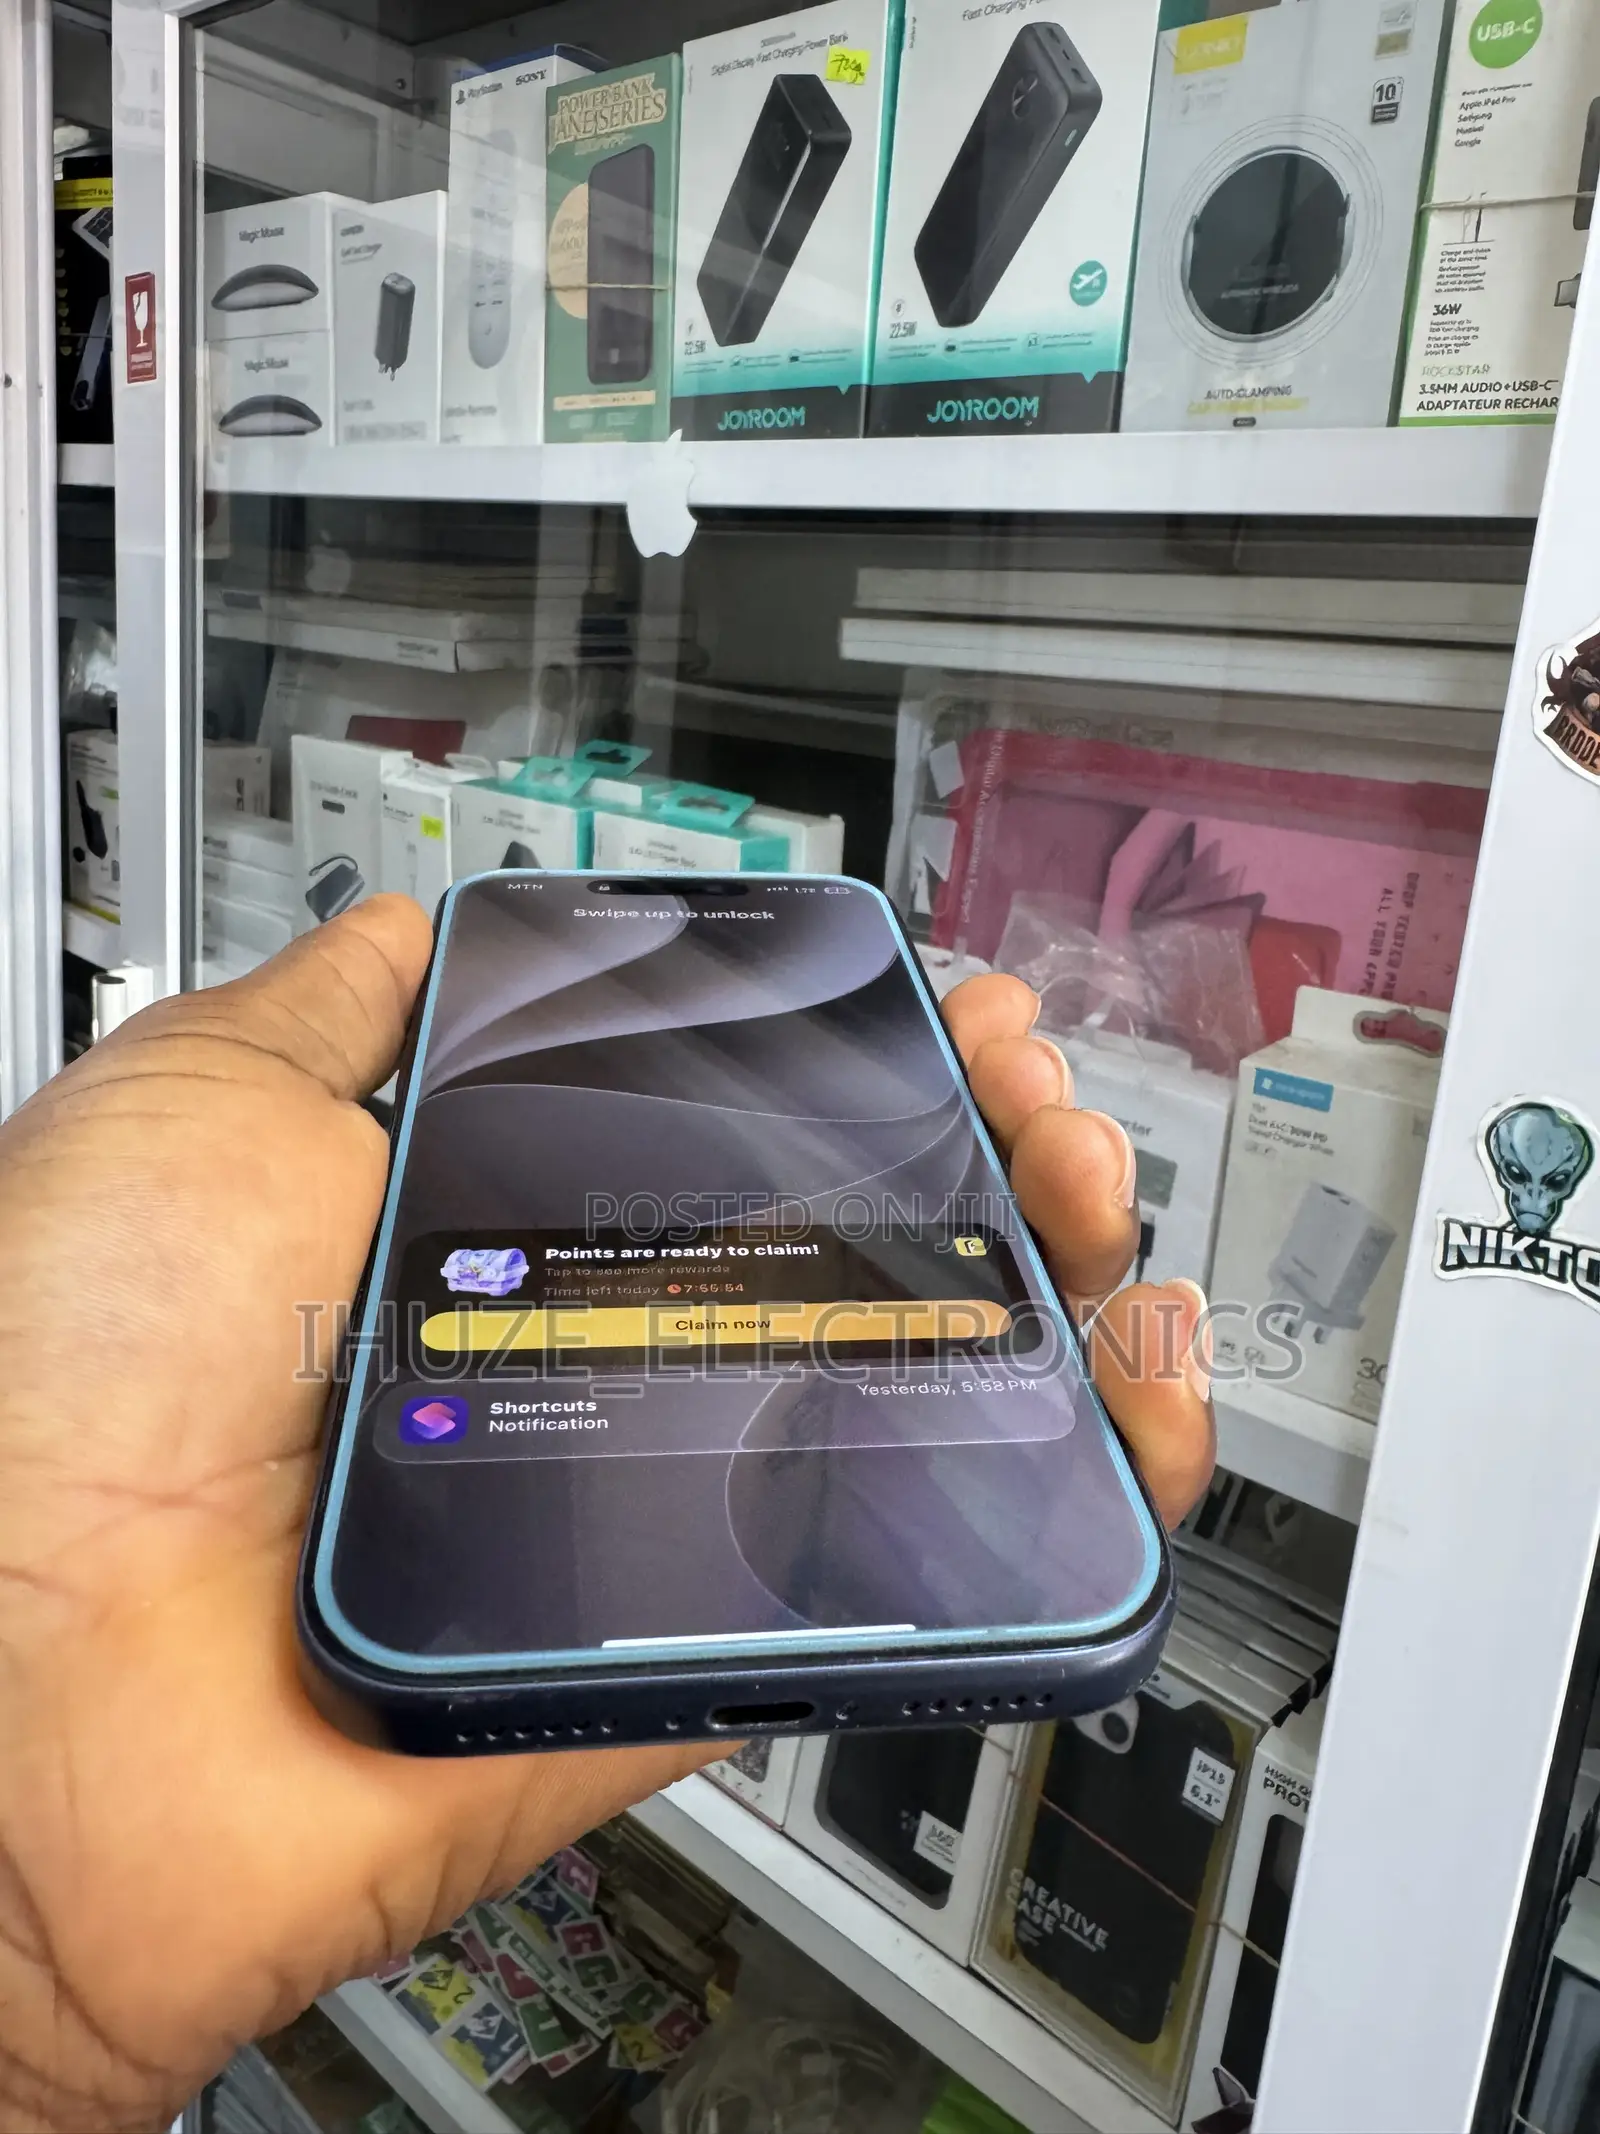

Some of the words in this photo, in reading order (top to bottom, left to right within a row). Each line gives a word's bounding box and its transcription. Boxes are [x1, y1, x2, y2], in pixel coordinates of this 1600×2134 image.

[962, 8, 983, 21] Fast
[1477, 16, 1536, 42] USB-C
[1432, 303, 1462, 316] 36W
[1419, 383, 1458, 395] 3.5MM
[1460, 381, 1503, 394] AUDIO
[1512, 380, 1558, 392] USB-C
[927, 396, 1040, 423] JOYROOM
[1416, 399, 1501, 411] ADAPTATEUR
[717, 405, 806, 431] JOYROOM
[508, 883, 544, 891] MTN
[573, 907, 641, 920] Swipe
[646, 909, 672, 920] up
[677, 909, 698, 919] to
[703, 909, 776, 920] unlock
[545, 1247, 616, 1260] Points
[620, 1247, 656, 1259] are
[661, 1244, 723, 1259] ready
[727, 1244, 750, 1257] to
[754, 1242, 820, 1256] claim!
[544, 1267, 571, 1278] Tap
[626, 1267, 665, 1276] more
[670, 1264, 731, 1275] rewards
[544, 1286, 582, 1297] Time
[586, 1285, 612, 1297] left
[617, 1284, 660, 1298] today
[675, 1318, 728, 1331] Claim
[733, 1319, 771, 1331] now
[856, 1381, 957, 1397] Yesterday,
[1007, 1379, 1037, 1391] PM
[490, 1400, 597, 1415] Shortcuts
[488, 1416, 609, 1433] Notification
[1010, 1867, 1110, 1951] CREATIVE
